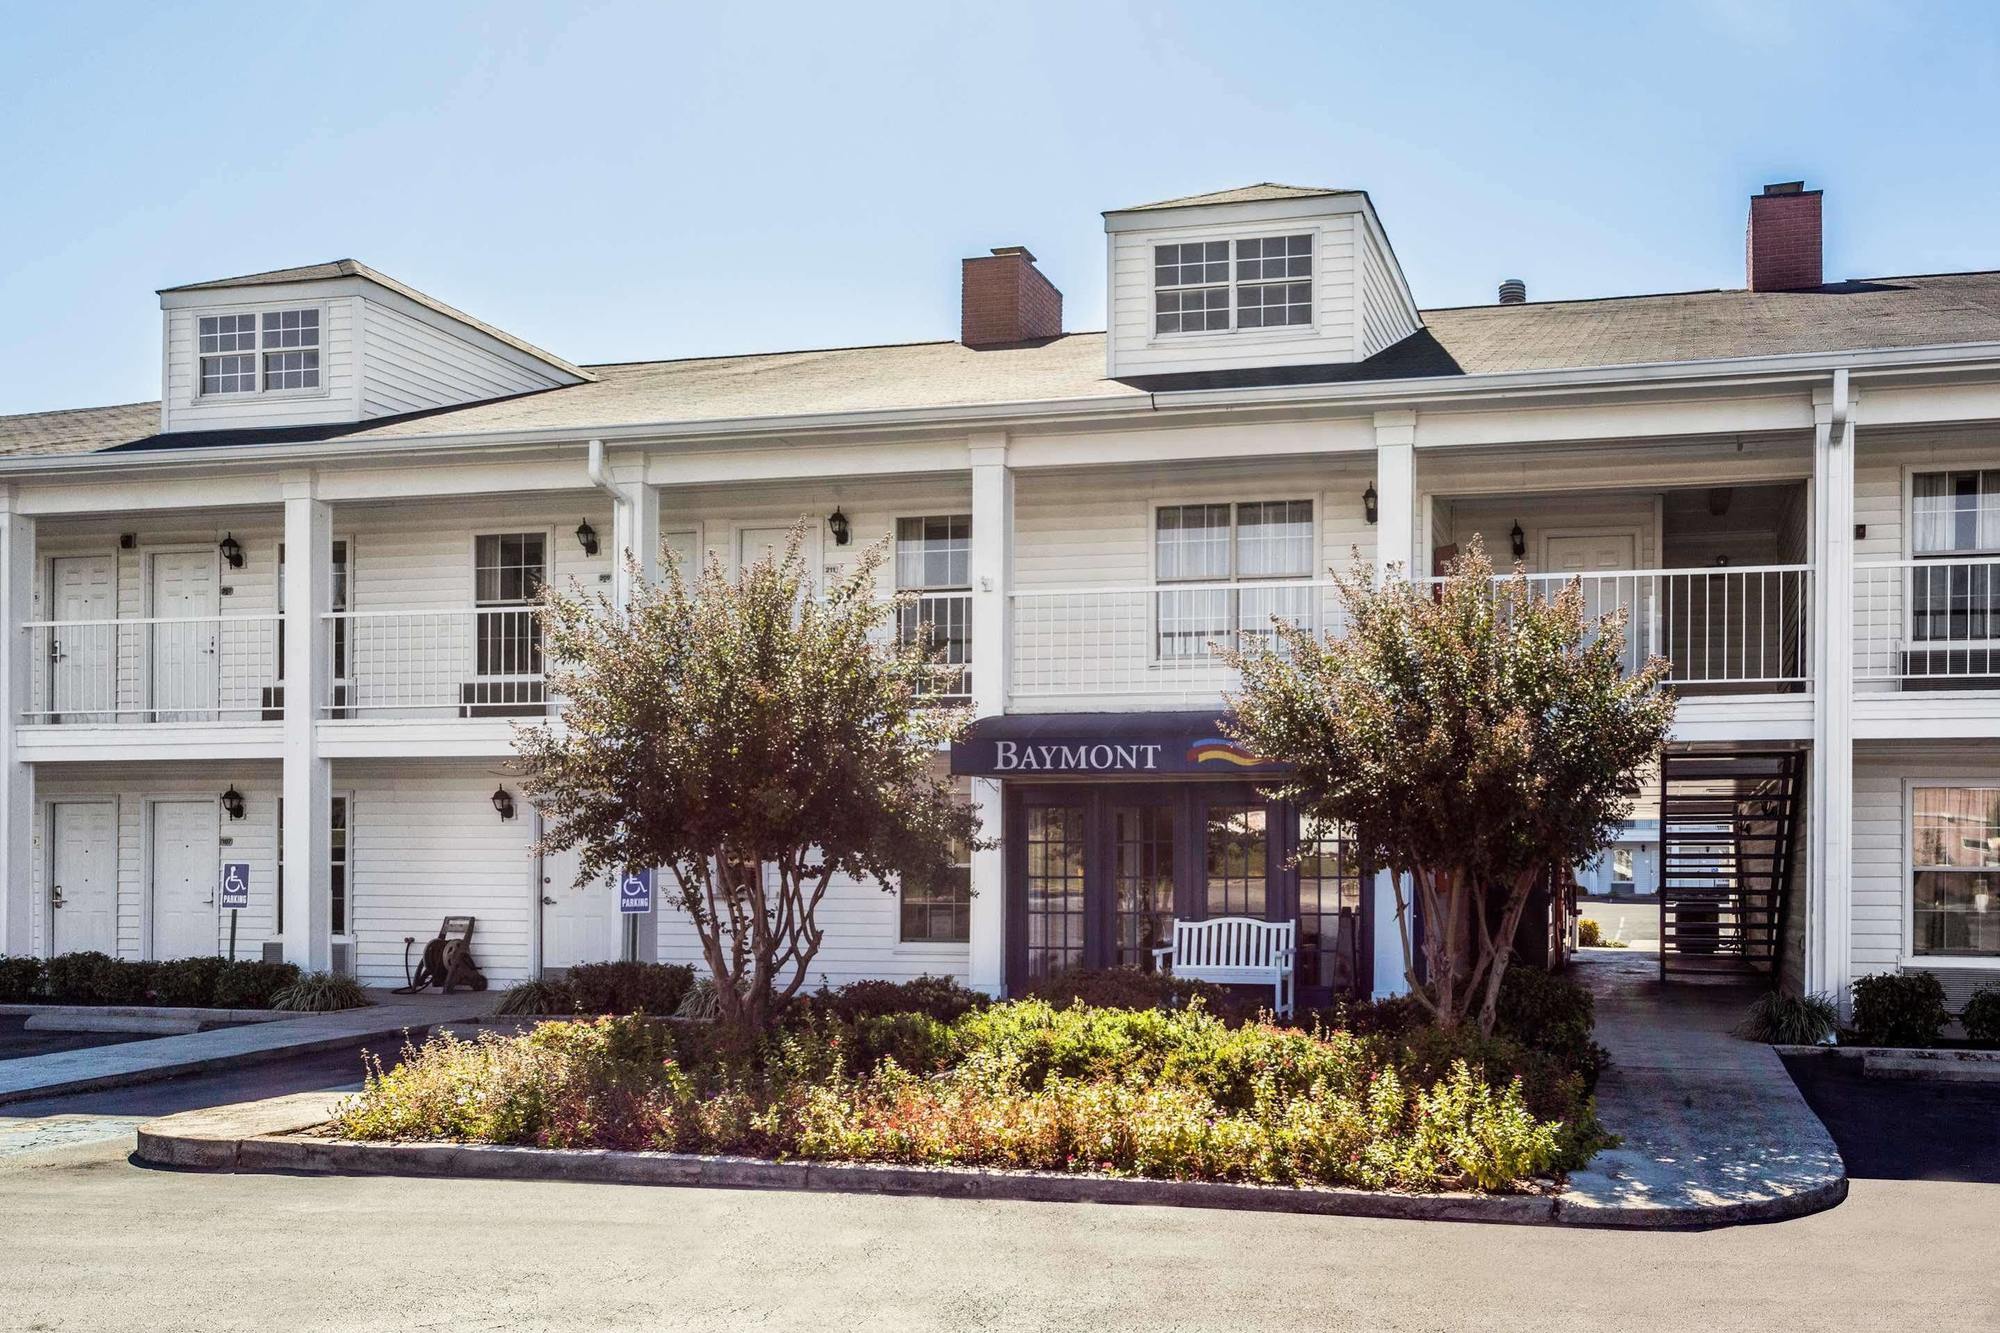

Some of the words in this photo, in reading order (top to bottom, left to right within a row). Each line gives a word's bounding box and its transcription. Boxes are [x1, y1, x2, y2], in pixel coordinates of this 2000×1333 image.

[993, 741, 1161, 770] BAYMONT
[223, 895, 247, 904] PARKING
[622, 898, 649, 908] PARKING
